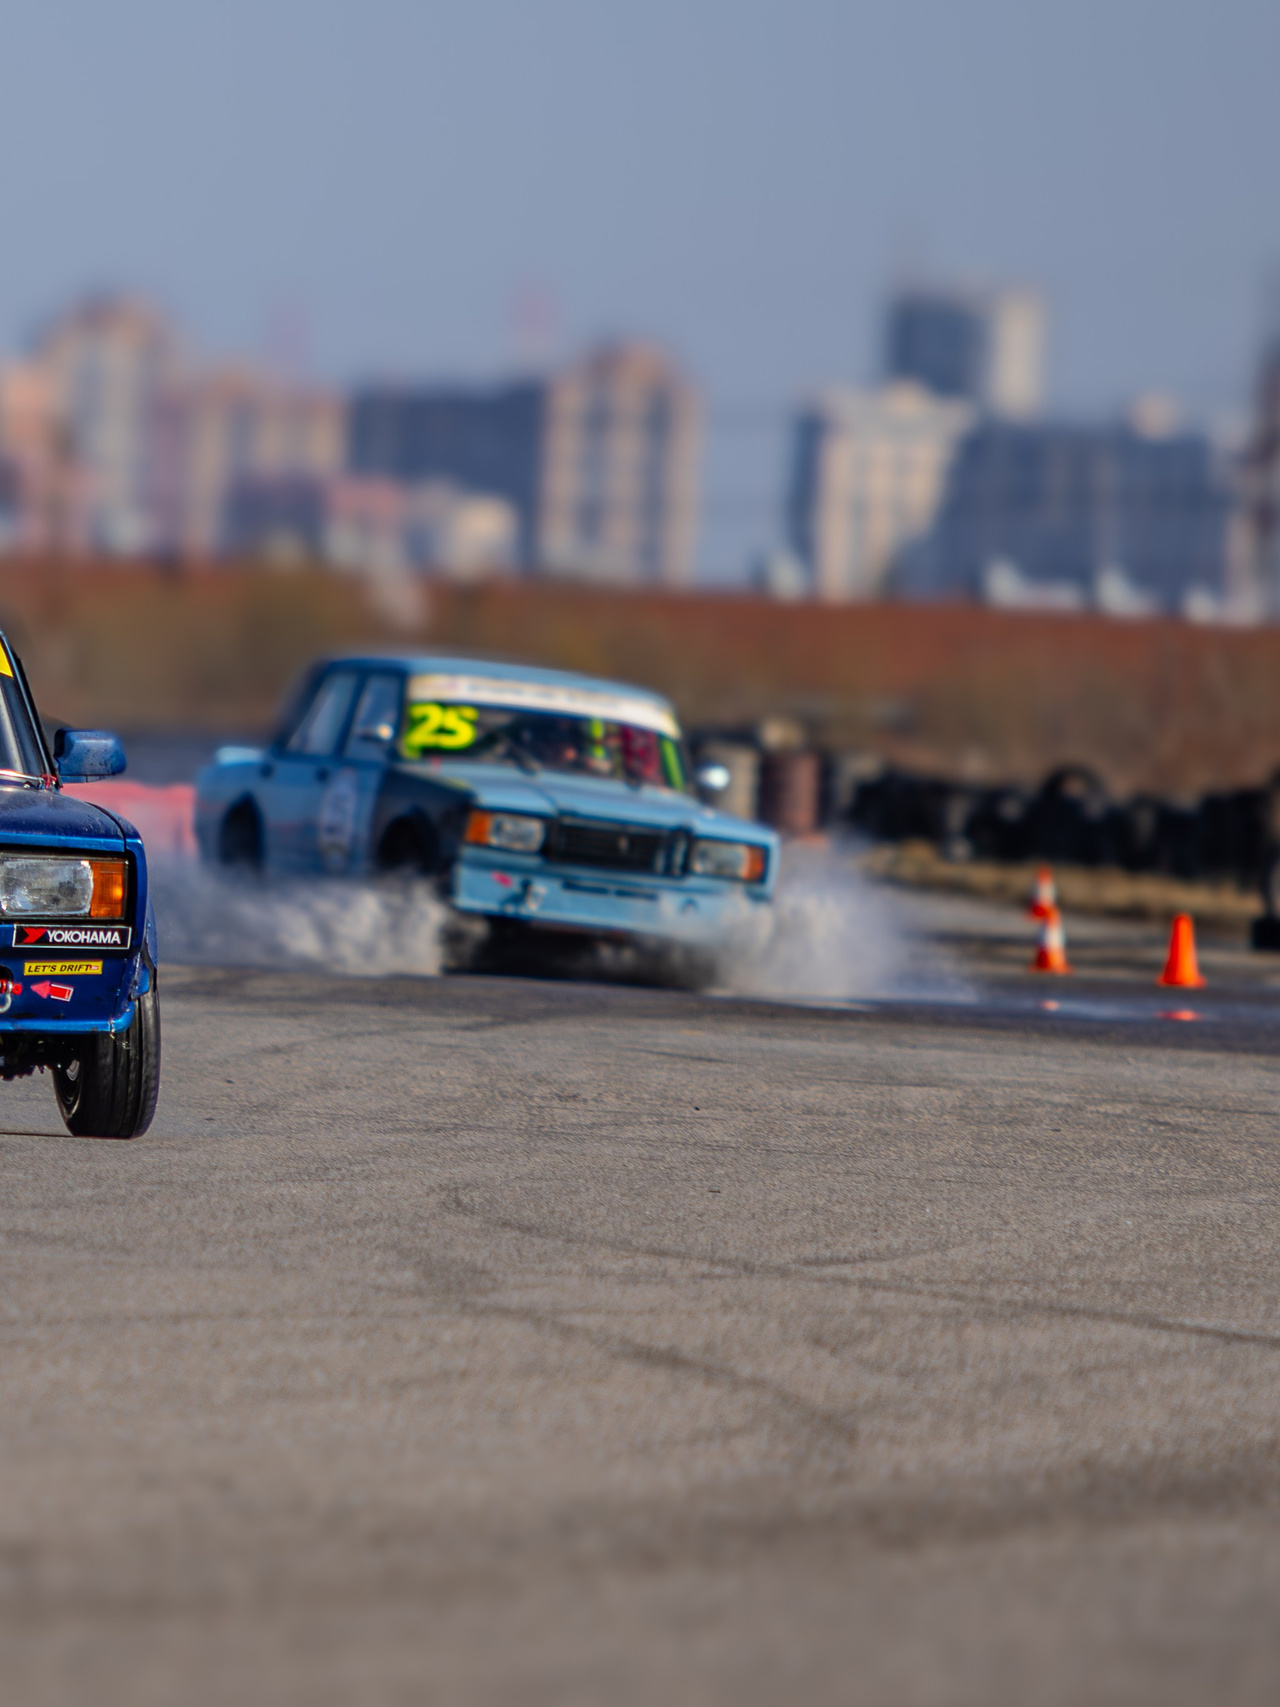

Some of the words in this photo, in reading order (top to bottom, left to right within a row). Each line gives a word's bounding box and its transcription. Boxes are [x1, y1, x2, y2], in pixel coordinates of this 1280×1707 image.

[404, 702, 479, 752] 25
[47, 930, 121, 944] YOKOHAMA
[27, 964, 57, 973] LET'S
[60, 964, 91, 973] DRIFT
